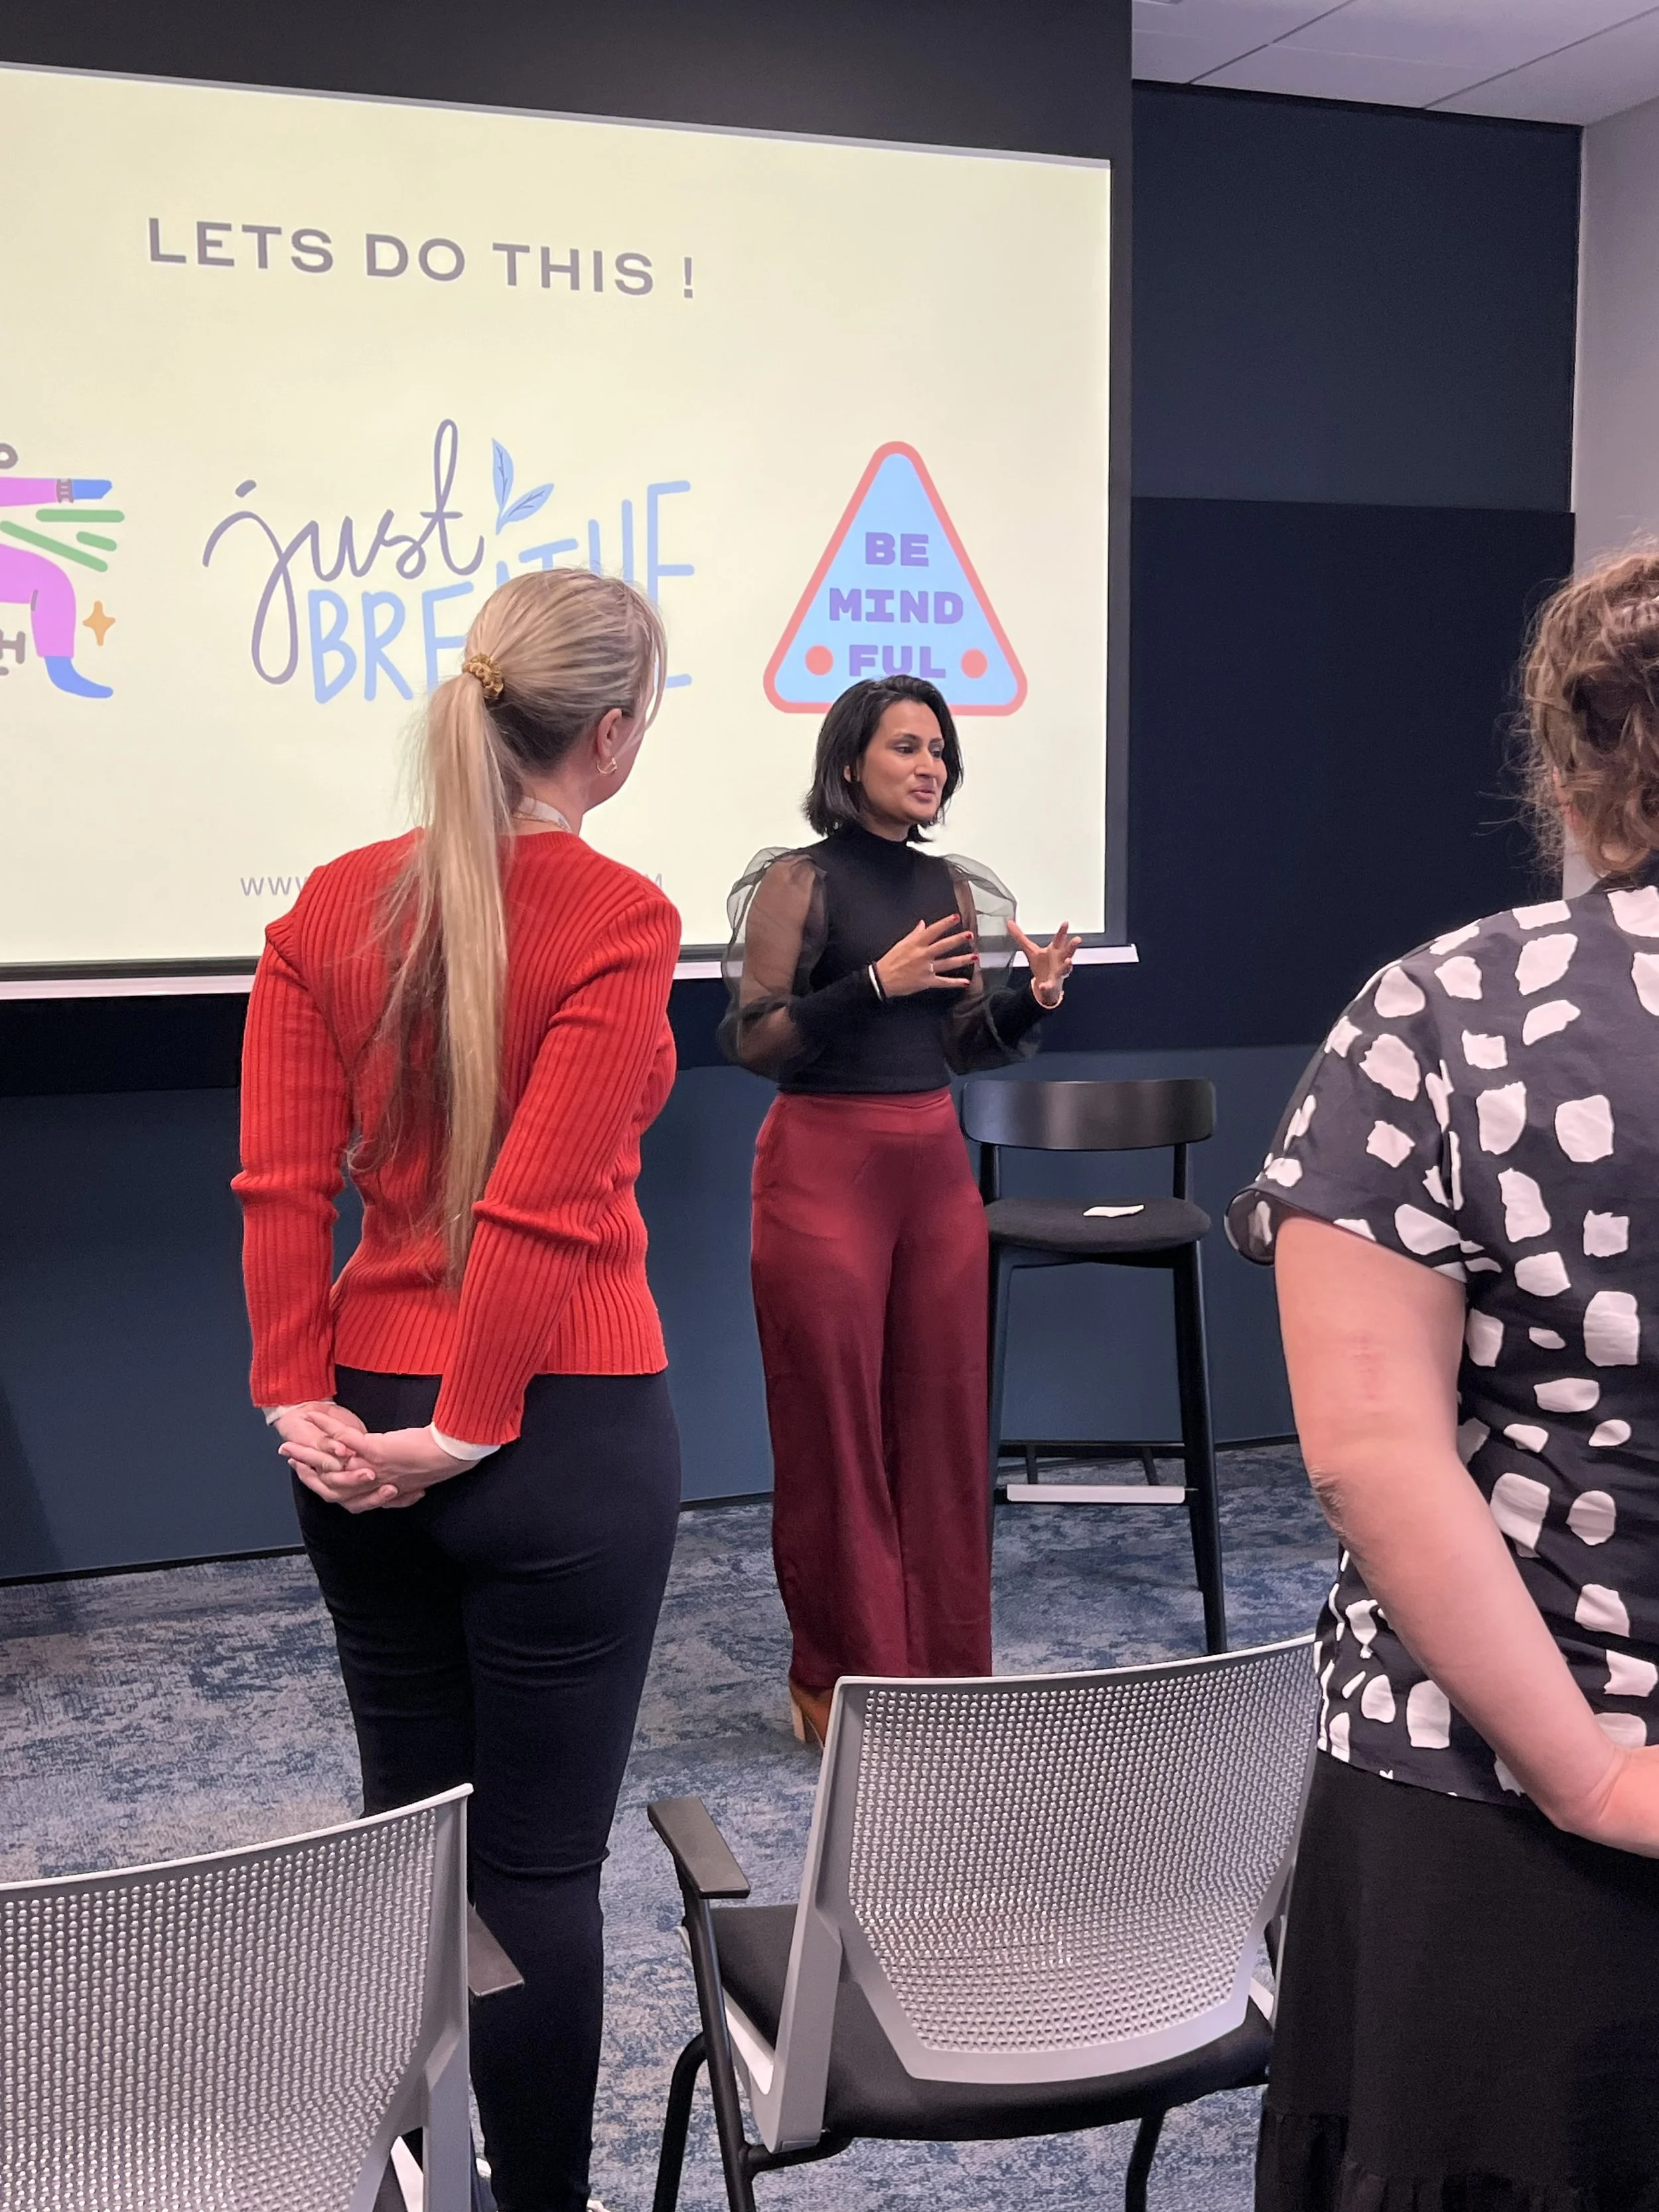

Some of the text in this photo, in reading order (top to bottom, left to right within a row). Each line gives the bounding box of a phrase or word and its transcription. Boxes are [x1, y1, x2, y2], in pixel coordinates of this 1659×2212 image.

[149, 217, 334, 273] LETS
[366, 233, 465, 281] DO
[492, 242, 654, 296] THIS
[202, 418, 485, 685] just
[865, 532, 930, 567] BE
[307, 480, 695, 704] BREE
[829, 587, 964, 625] MIND
[849, 644, 947, 679] FUL
